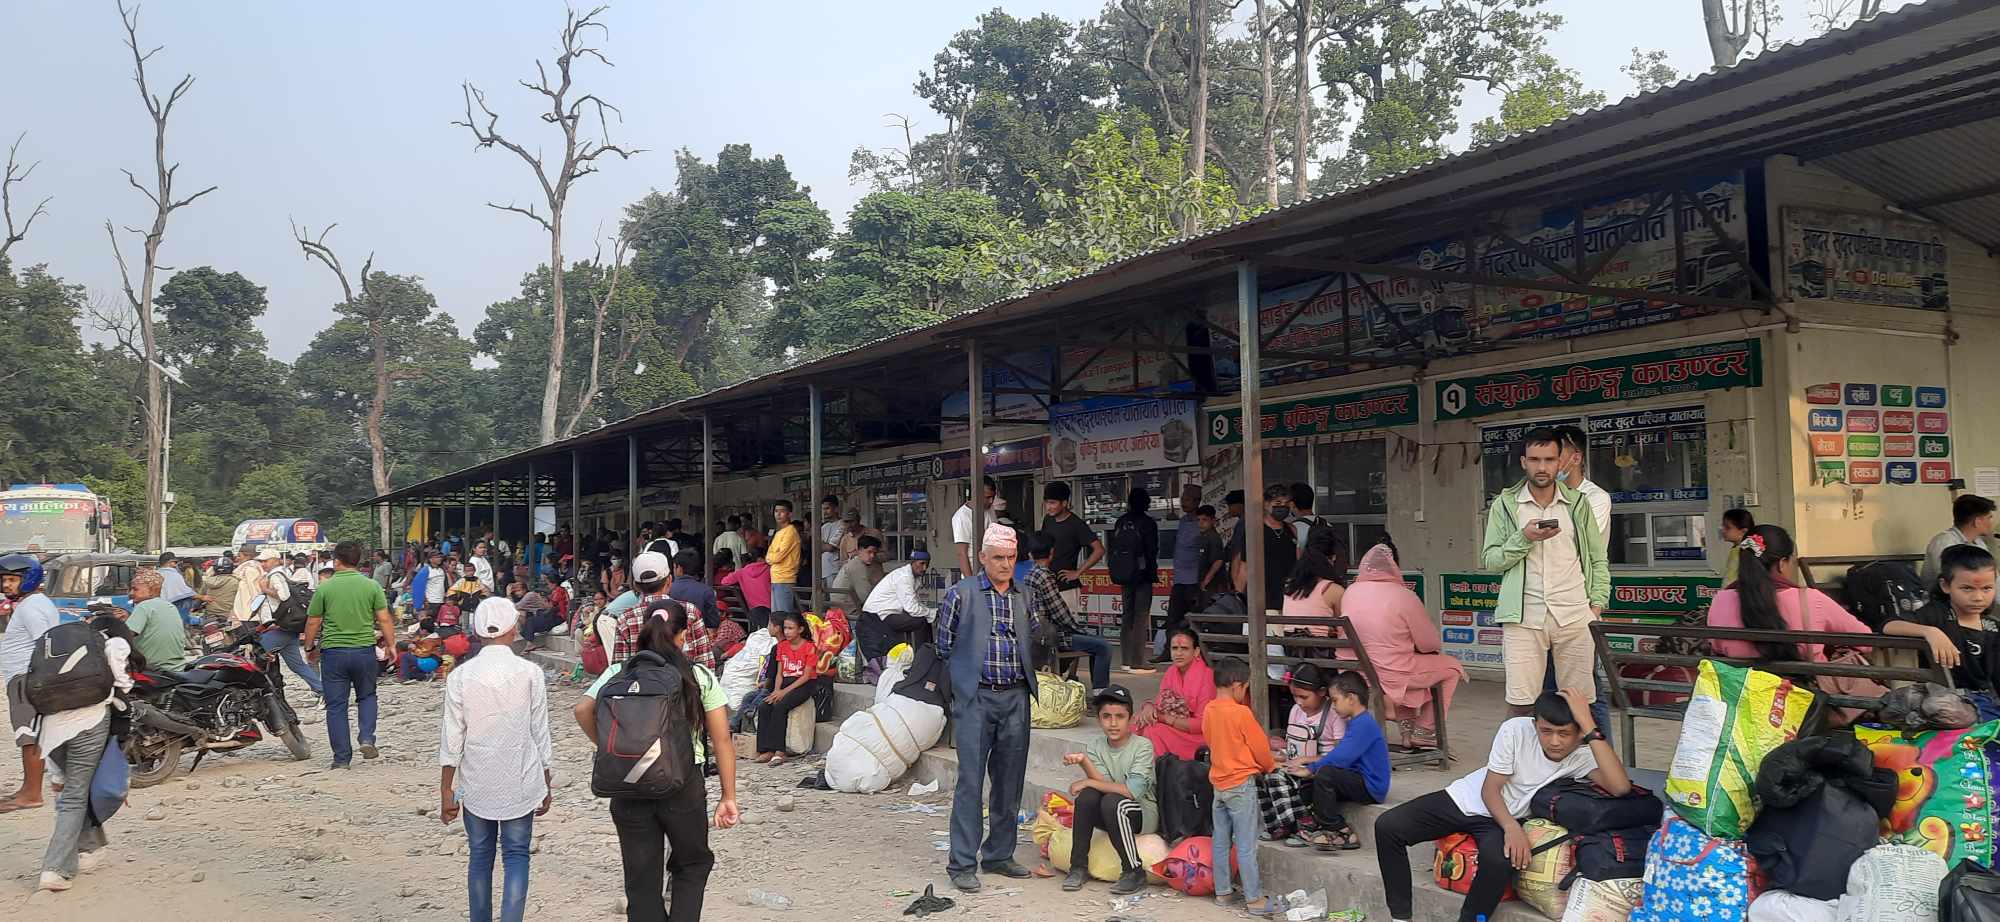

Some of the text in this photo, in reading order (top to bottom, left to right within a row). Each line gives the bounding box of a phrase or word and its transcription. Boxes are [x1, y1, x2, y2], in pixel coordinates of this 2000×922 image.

[1632, 351, 1749, 386] काउण्टर
[1588, 416, 1613, 433] सुन्दर
[1614, 585, 1687, 604] काउण्टर
